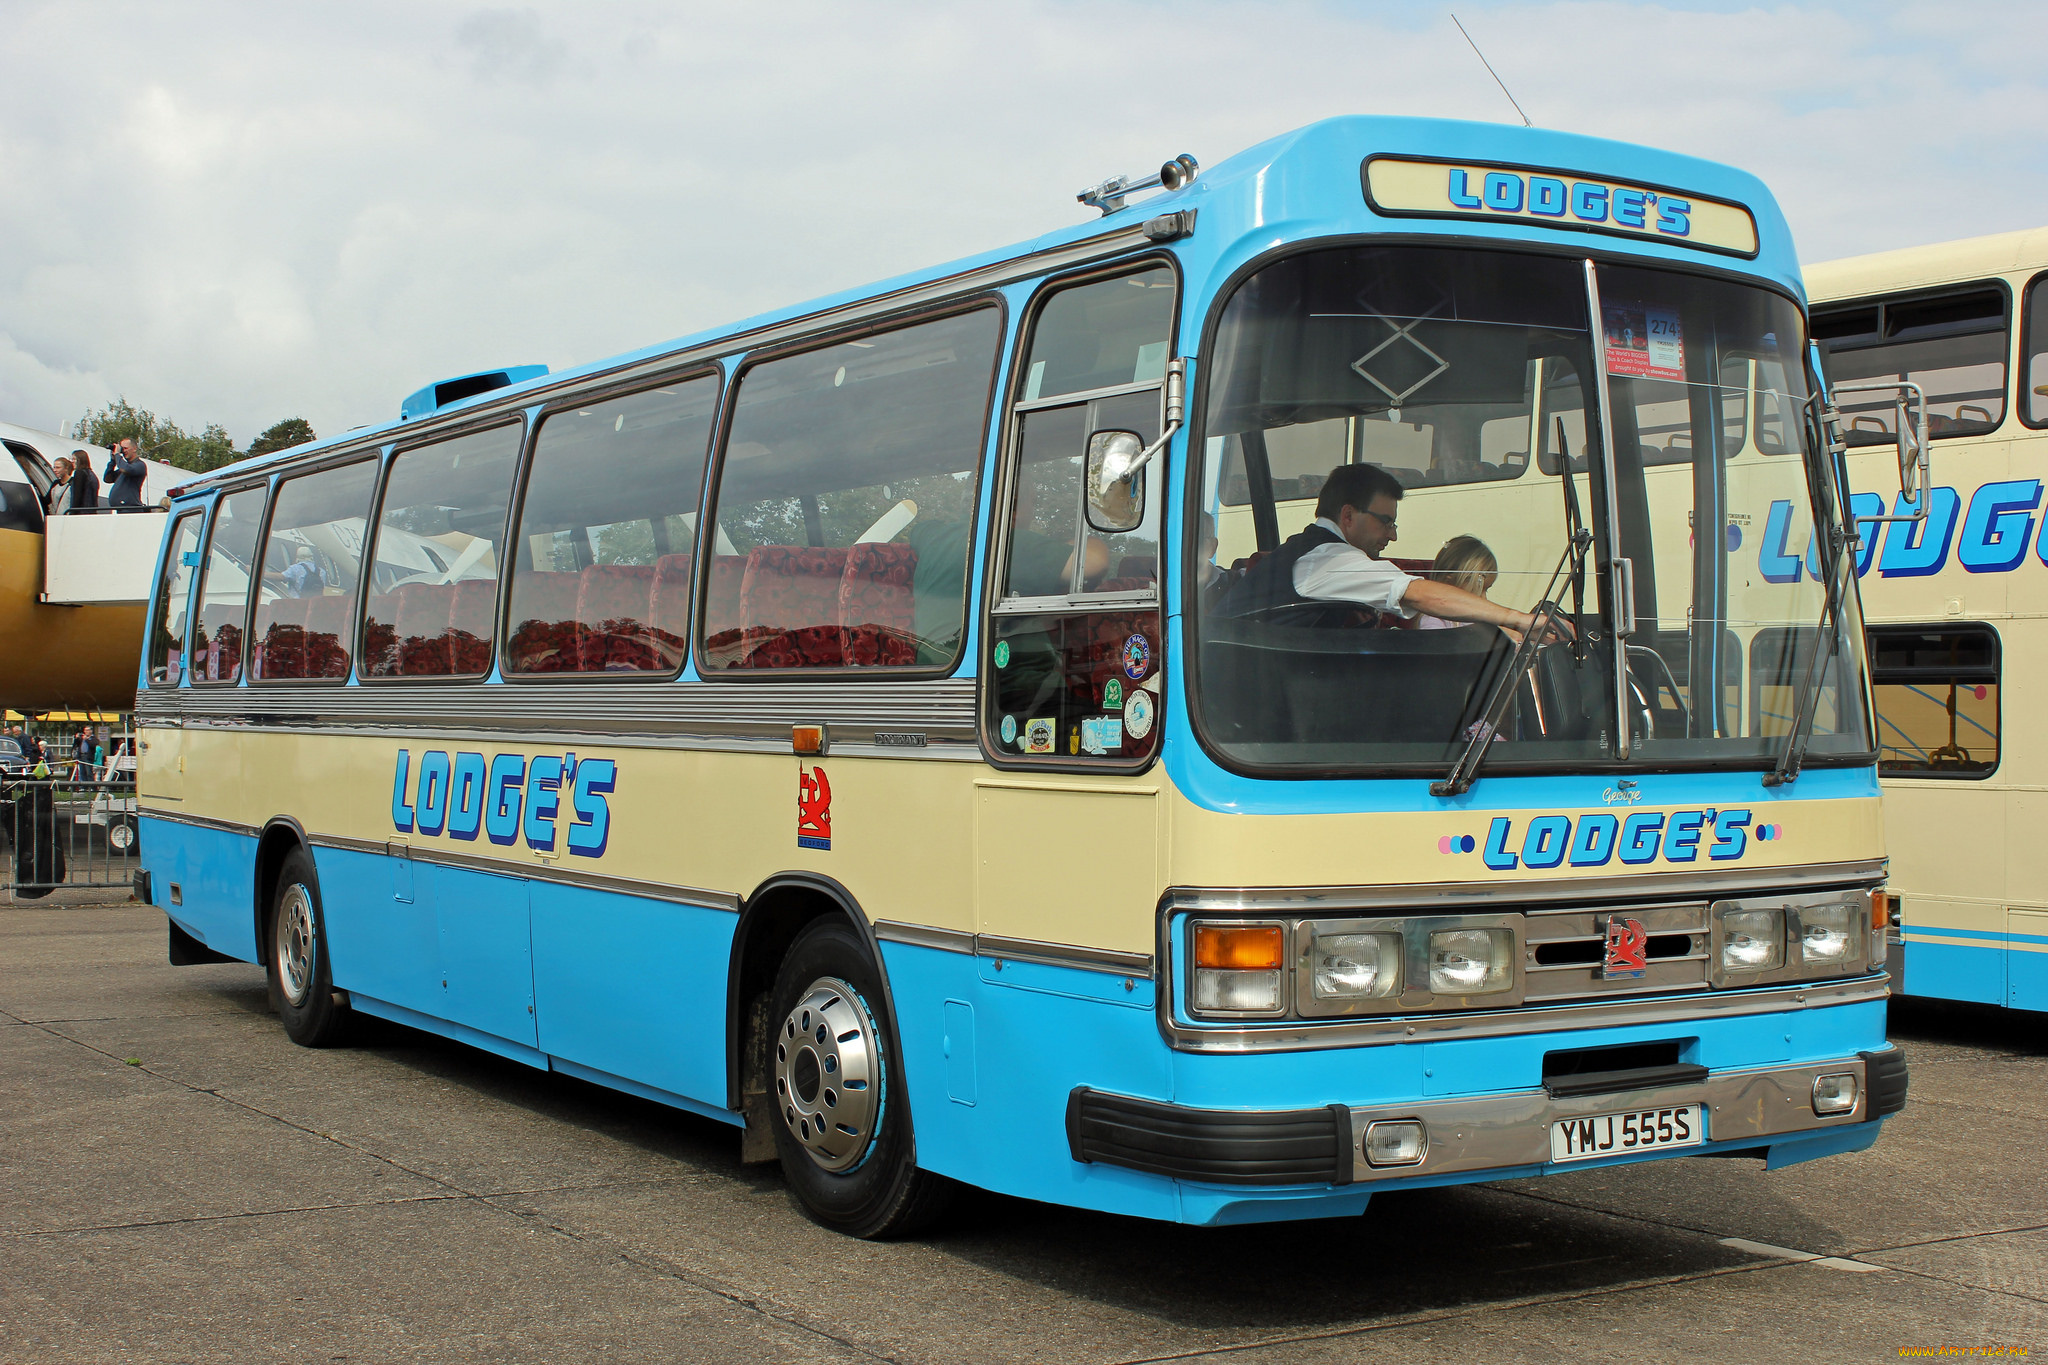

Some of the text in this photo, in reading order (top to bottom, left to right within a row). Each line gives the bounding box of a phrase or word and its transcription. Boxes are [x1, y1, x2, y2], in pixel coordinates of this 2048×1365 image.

[1448, 168, 1691, 237] LODGE'S
[1651, 319, 1677, 336] 274
[1758, 478, 2048, 584] LODG
[391, 748, 618, 859] LODGE'S
[1602, 787, 1642, 805] George
[800, 840, 830, 848] BEDFORD
[1482, 808, 1753, 871] LODGE'S
[1560, 1108, 1690, 1154] YMJ 555S
